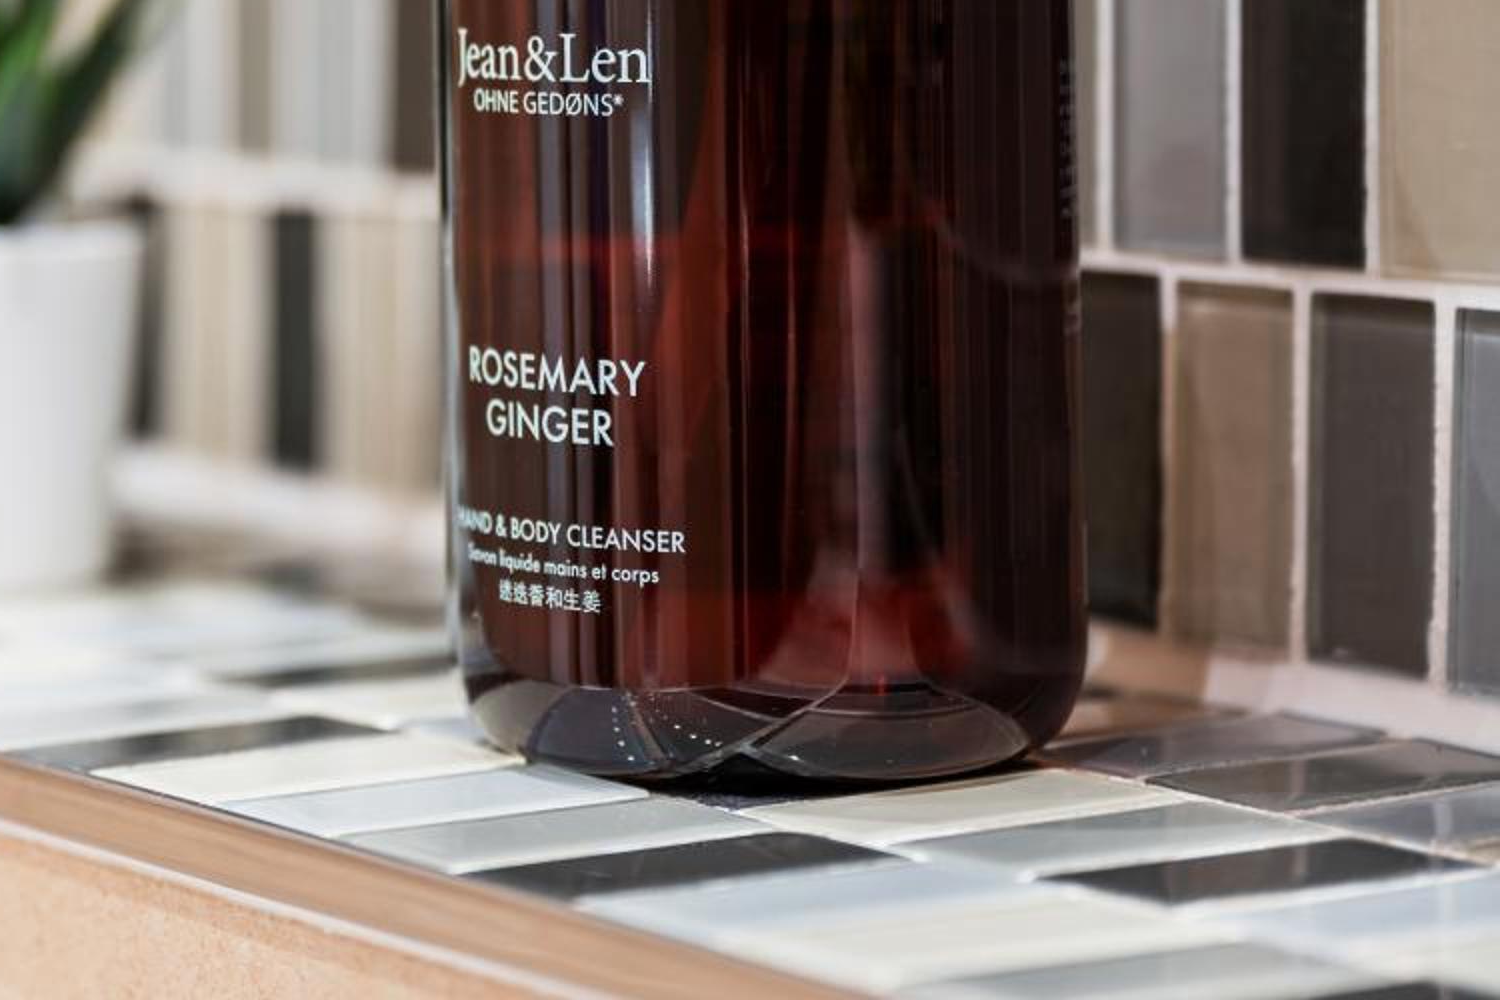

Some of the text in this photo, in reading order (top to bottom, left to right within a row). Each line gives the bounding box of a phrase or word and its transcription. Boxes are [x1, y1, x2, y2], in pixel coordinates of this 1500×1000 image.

[458, 27, 651, 87] Jean&Len
[473, 88, 519, 113] OHNE
[468, 345, 646, 397] ROSEMARY
[486, 399, 614, 447] GINGER
[495, 513, 507, 537] &
[510, 516, 560, 545] BODY
[566, 524, 686, 553] CLEANSER
[499, 549, 541, 575] liquide
[544, 559, 587, 580] mains
[592, 563, 607, 580] et
[611, 567, 660, 588] corps
